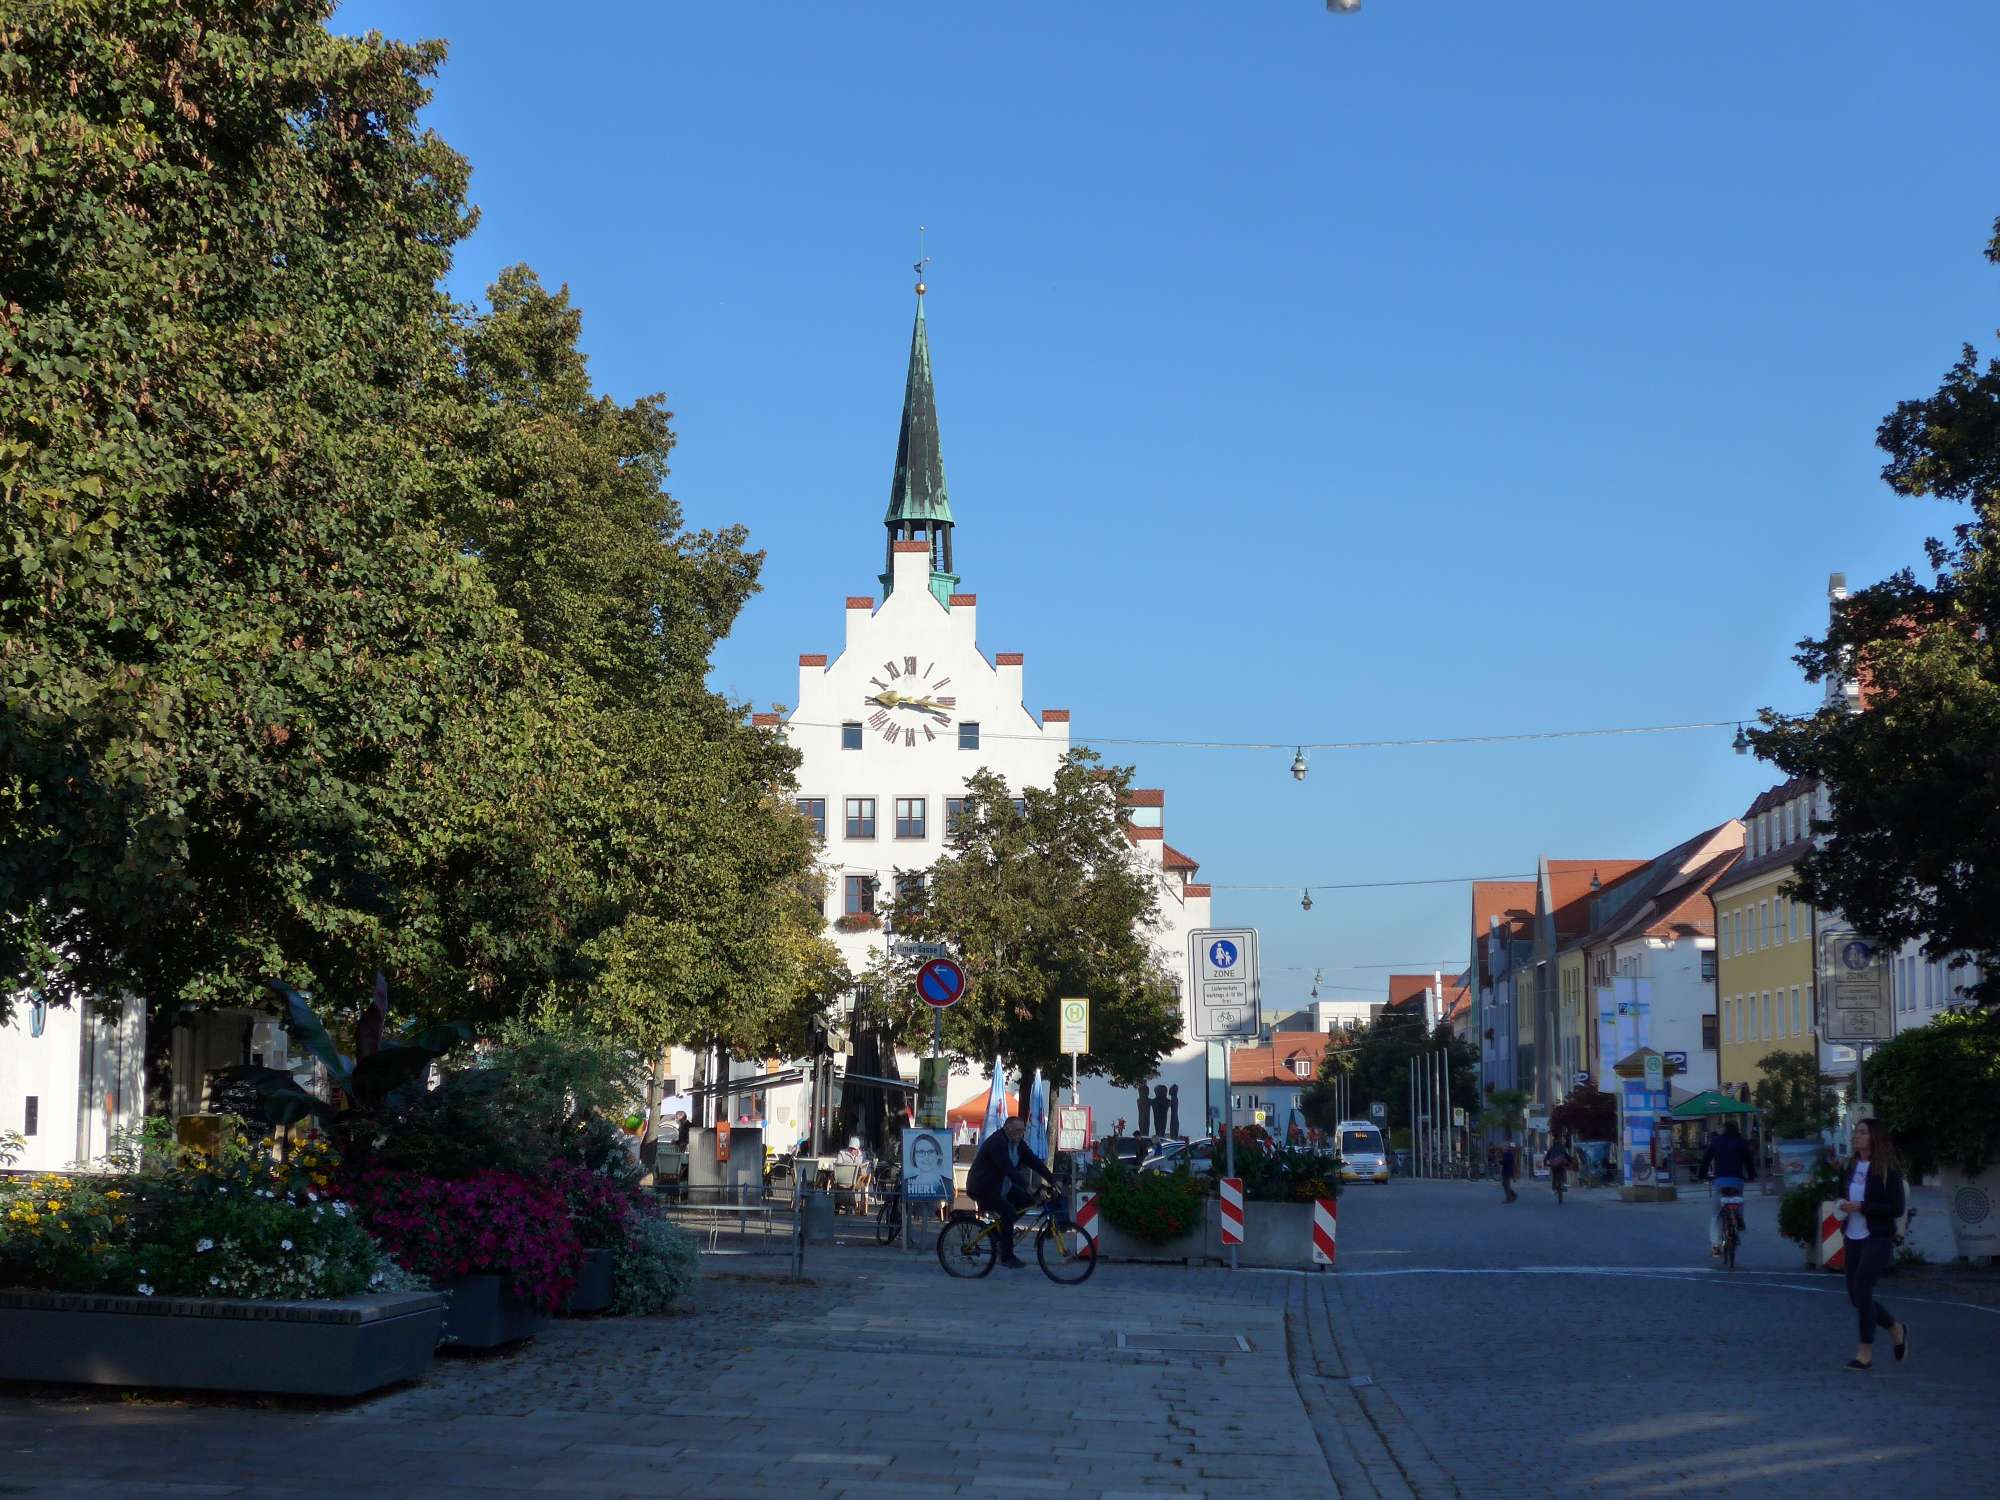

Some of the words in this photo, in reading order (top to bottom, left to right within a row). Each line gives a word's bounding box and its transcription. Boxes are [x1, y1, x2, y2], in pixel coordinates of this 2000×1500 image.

[897, 943, 915, 953] Ulmer
[917, 945, 938, 954] Gasse
[1213, 969, 1236, 977] ZONE
[907, 1184, 937, 1194] HIERL
